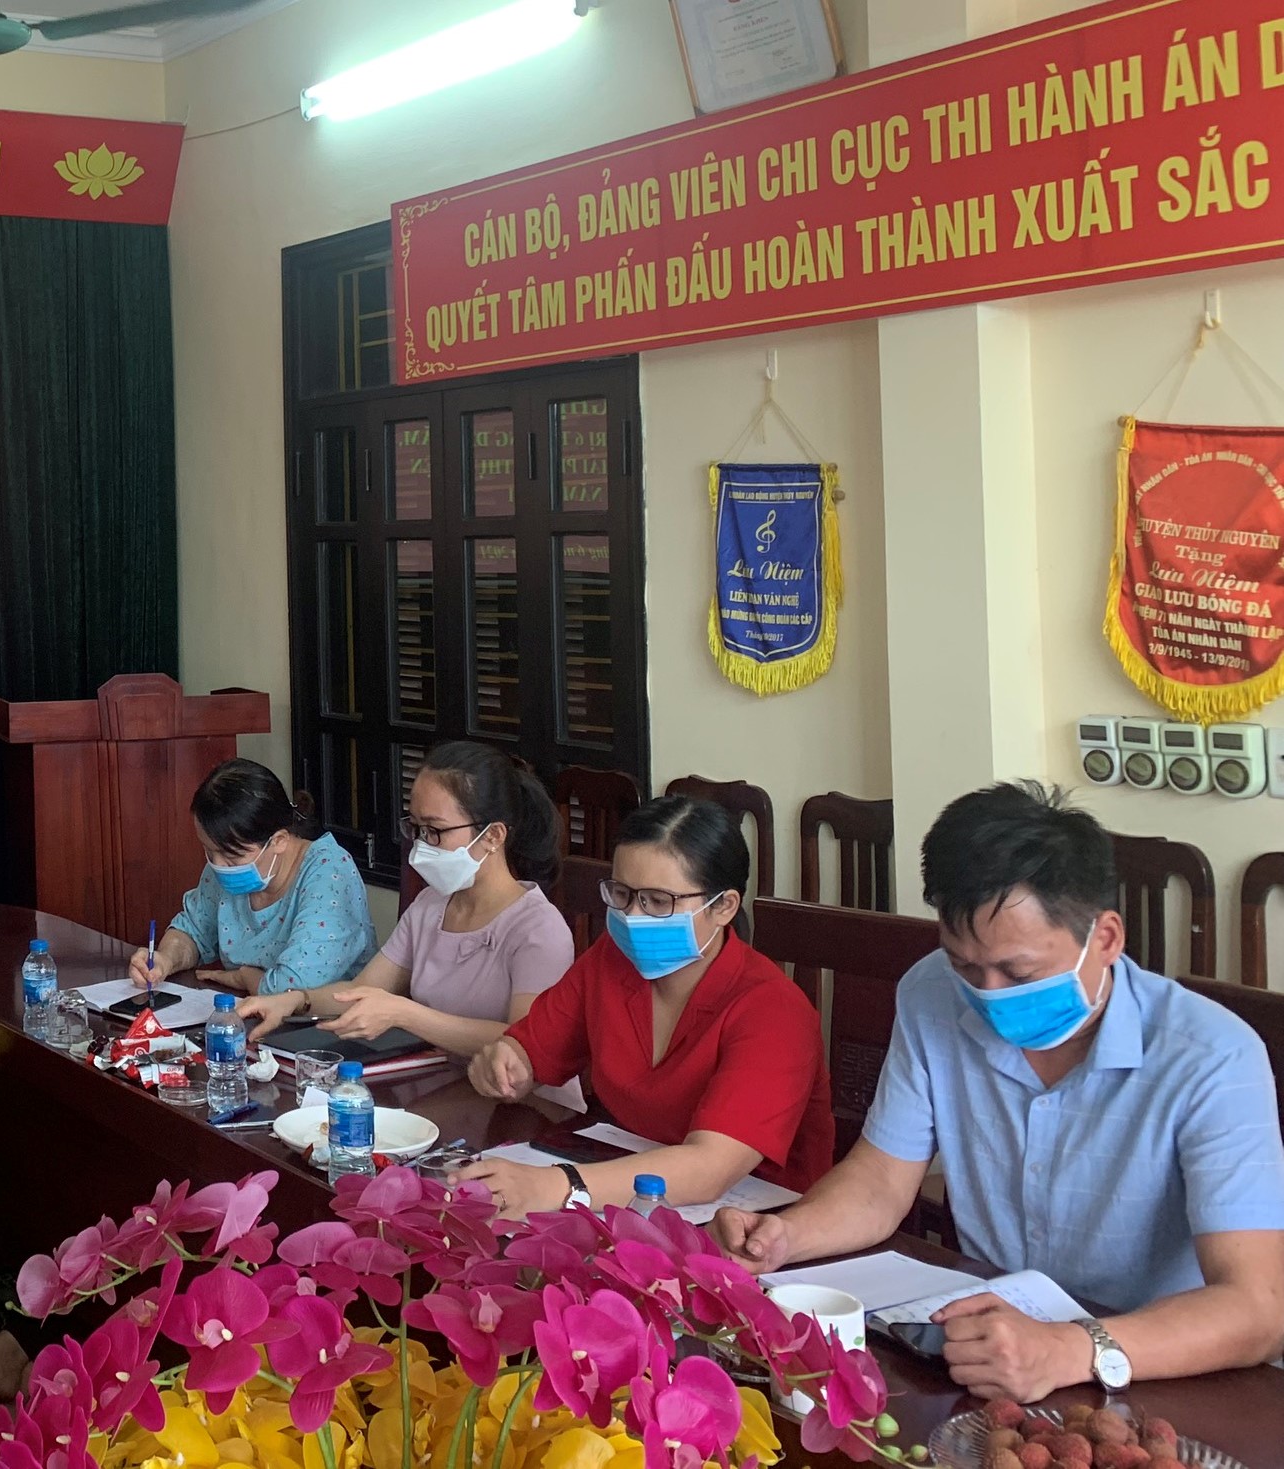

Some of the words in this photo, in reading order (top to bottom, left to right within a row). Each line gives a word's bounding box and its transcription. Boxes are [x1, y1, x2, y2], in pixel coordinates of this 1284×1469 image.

[464, 210, 517, 268] CÁN
[525, 193, 570, 260] BỘ,
[578, 168, 660, 242] ĐẢNG
[669, 152, 746, 221] VIÊN
[758, 137, 817, 201] CHI
[830, 115, 910, 191] CỤC
[923, 93, 992, 164] THI
[1007, 54, 1144, 146] HÀNH
[1162, 28, 1241, 112] ÁN
[426, 279, 500, 354] QUYẾT
[508, 277, 566, 334] TÂM
[575, 247, 656, 323] PHẤN
[666, 232, 732, 308] ĐẤU
[743, 220, 844, 294] HOÀN
[856, 196, 997, 275] THÀNH
[1011, 147, 1139, 249] XUẤT
[1157, 125, 1271, 223] SẮC
[1175, 545, 1227, 566] Tặng
[760, 560, 804, 586] Niệm
[1191, 568, 1260, 595] Niệm
[1164, 589, 1194, 607] LƯU
[1197, 593, 1243, 614] BÓNG
[1246, 600, 1272, 618] ĐÁ
